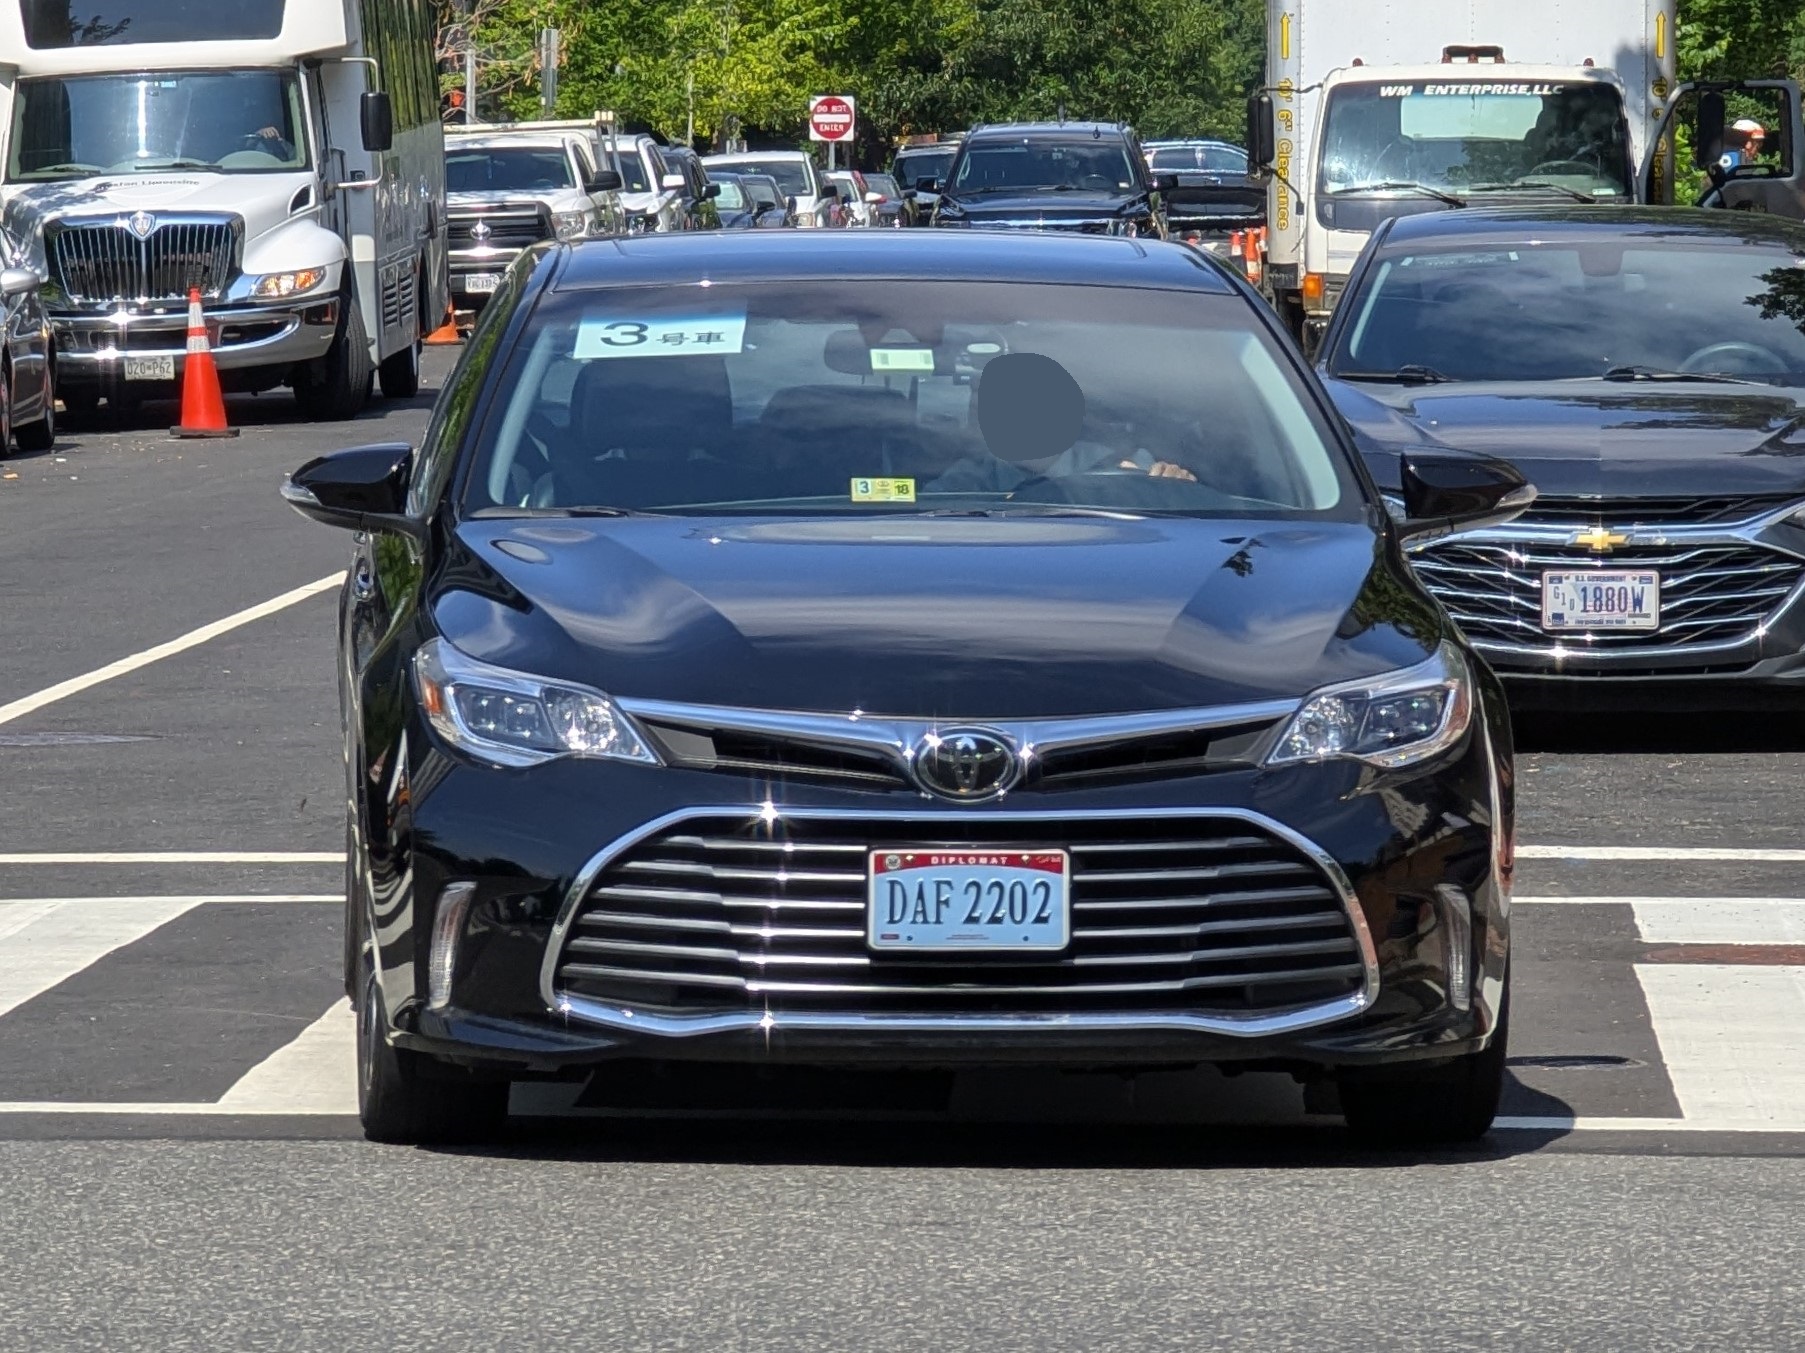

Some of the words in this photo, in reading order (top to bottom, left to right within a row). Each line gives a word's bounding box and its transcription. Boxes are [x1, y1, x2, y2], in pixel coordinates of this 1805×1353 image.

[1380, 85, 1413, 97] WM
[820, 124, 844, 132] ENTER
[860, 481, 869, 494] 3
[895, 484, 910, 494] 18
[1581, 585, 1645, 613] 1880W
[931, 856, 1008, 865] DIPLOMAT
[886, 878, 954, 925] DAF
[962, 878, 1052, 925] 2202
